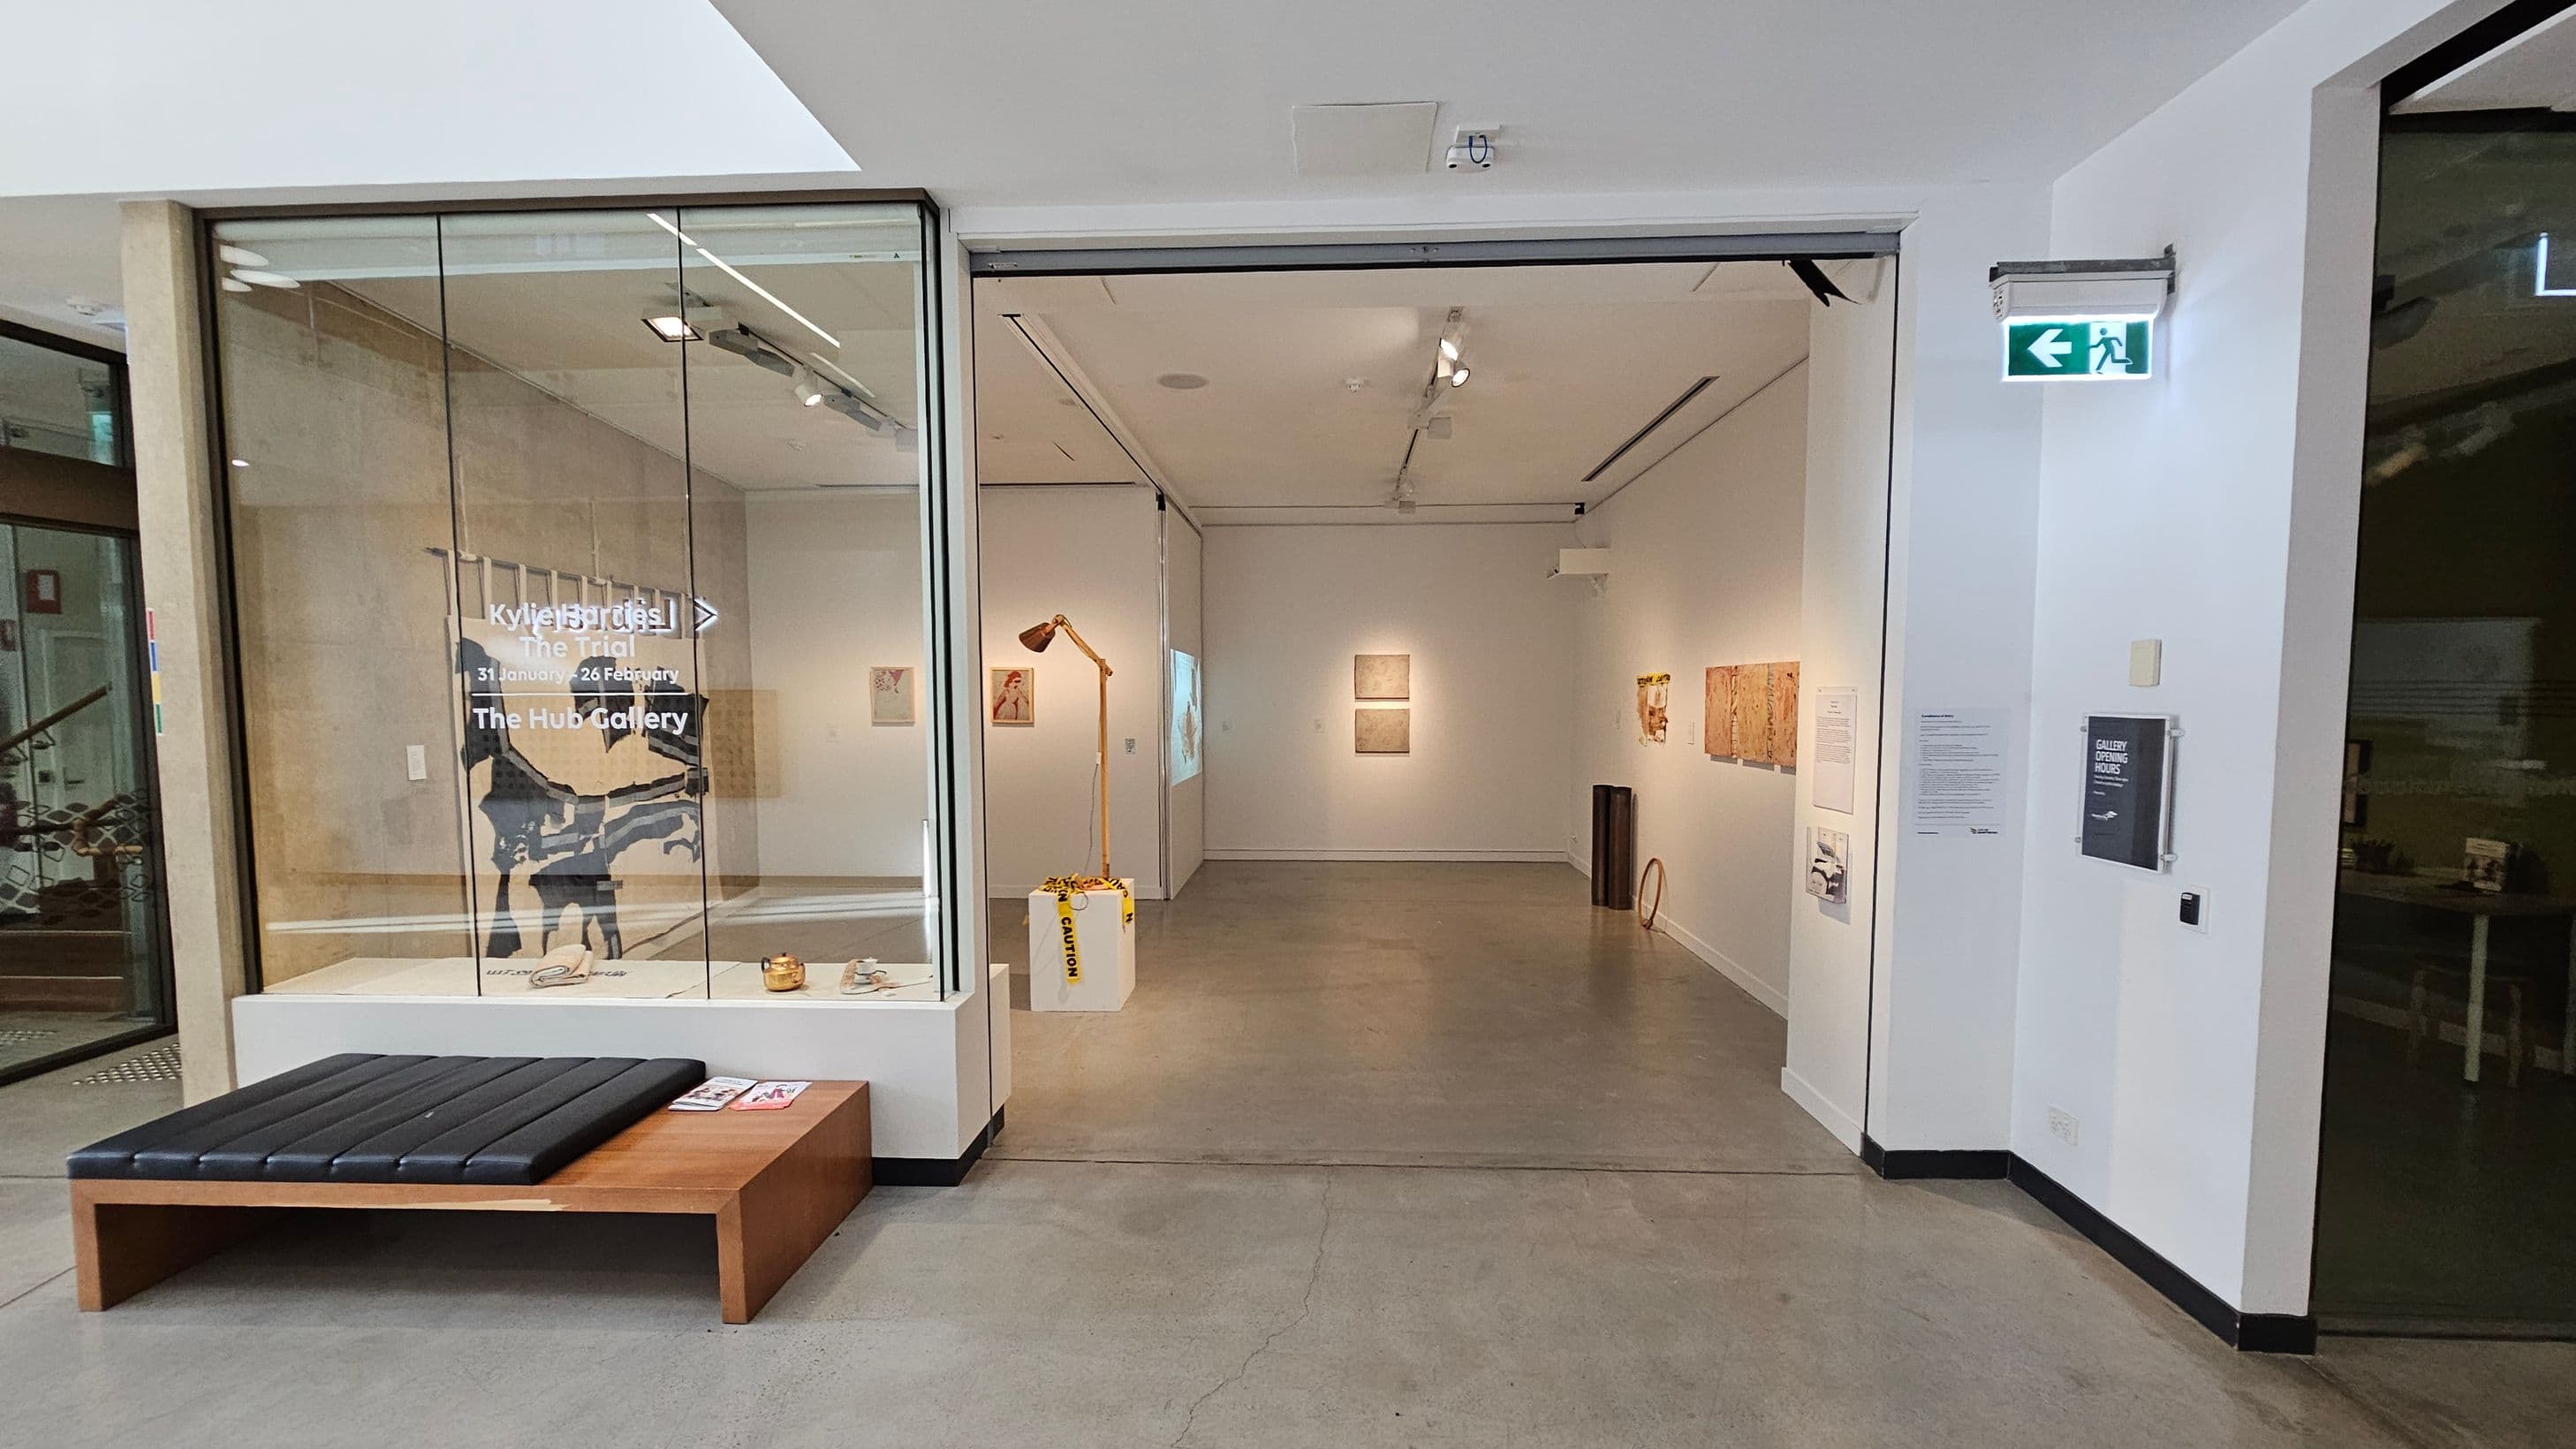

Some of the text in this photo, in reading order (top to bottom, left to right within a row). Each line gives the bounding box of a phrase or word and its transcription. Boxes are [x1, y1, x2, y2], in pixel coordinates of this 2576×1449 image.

[490, 603, 553, 631] Kylie
[519, 634, 635, 657] The Trial
[477, 668, 494, 681] 31
[498, 667, 564, 685] January
[580, 667, 601, 681] 26
[604, 667, 679, 684] February
[473, 707, 689, 735] The Hub Gallery
[2096, 740, 2127, 751] GALLERY
[2095, 751, 2127, 763] OPENING
[2095, 763, 2120, 774] HOURS
[1061, 916, 1078, 977] CAUTION
